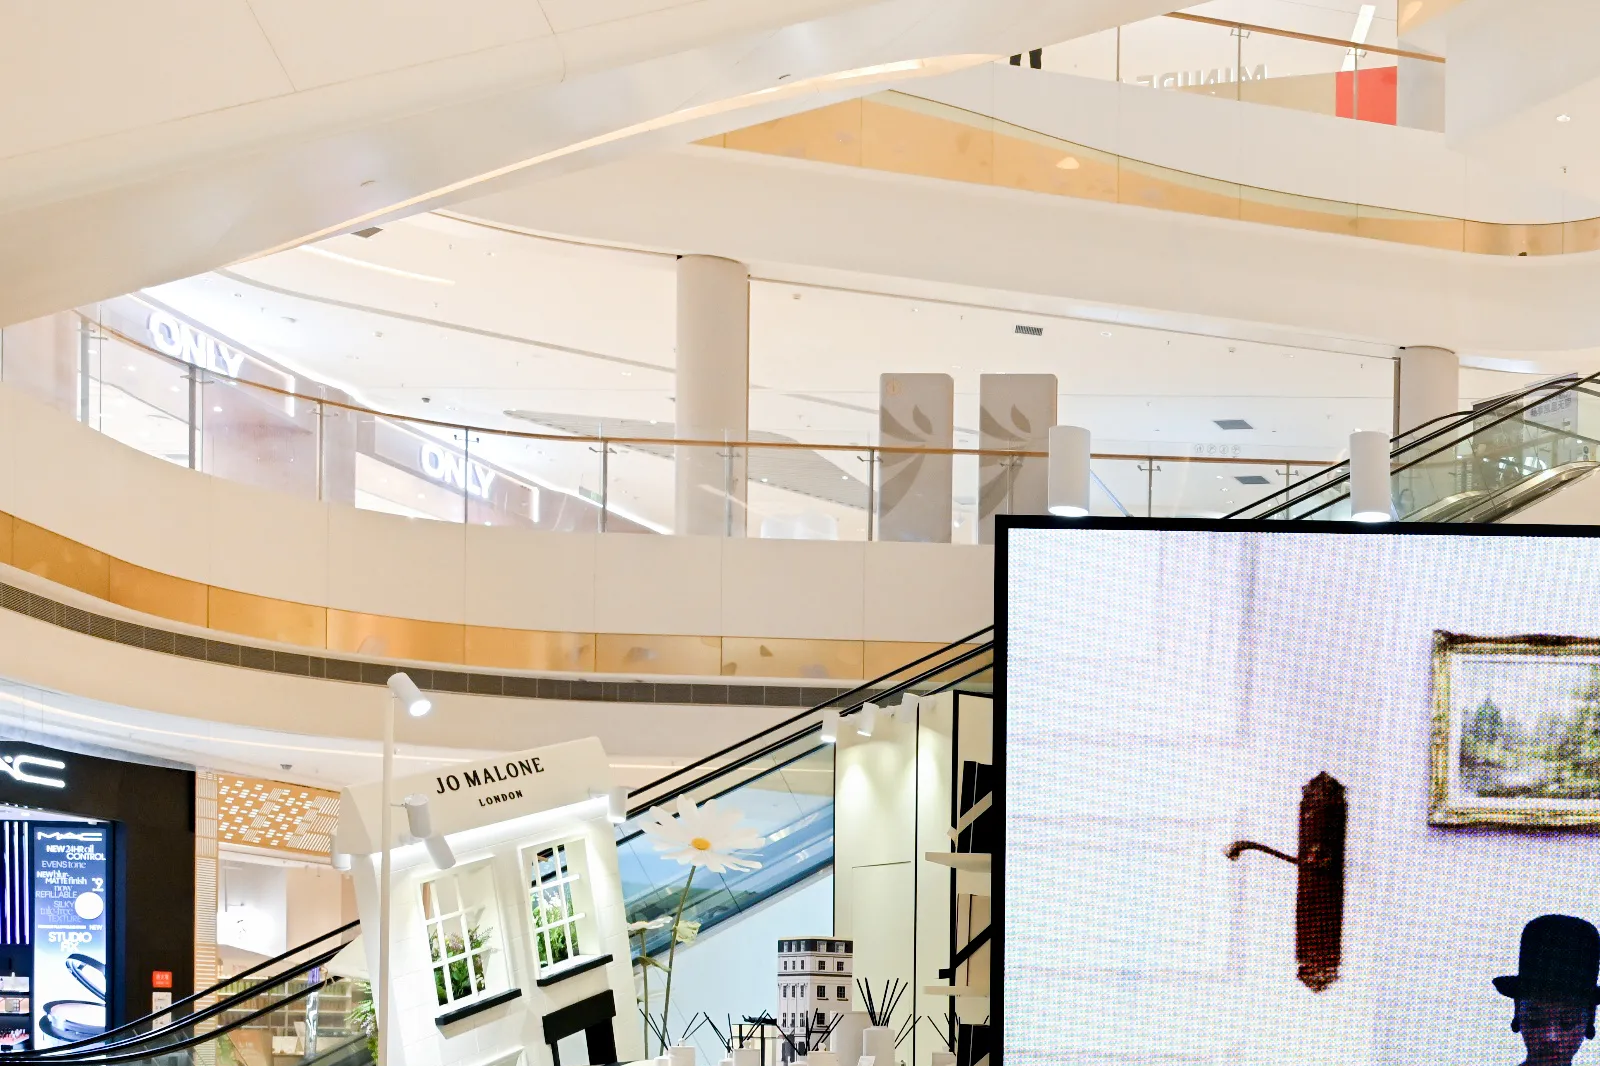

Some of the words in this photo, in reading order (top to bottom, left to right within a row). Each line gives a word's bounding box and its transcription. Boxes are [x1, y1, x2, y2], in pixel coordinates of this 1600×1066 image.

[148, 310, 244, 379] ONLY
[420, 443, 496, 499] ONLY
[436, 774, 461, 794] JO
[463, 757, 545, 788] MALONE
[478, 789, 523, 807] LONDON
[46, 845, 65, 853] NEW
[66, 852, 107, 861] CONTROL
[41, 860, 67, 869] EVENS
[36, 870, 53, 878] NEW
[45, 877, 68, 885] MATTE
[35, 890, 78, 899] REFILLABLE
[53, 900, 75, 908] SILKY
[48, 931, 93, 943] STUDIO
